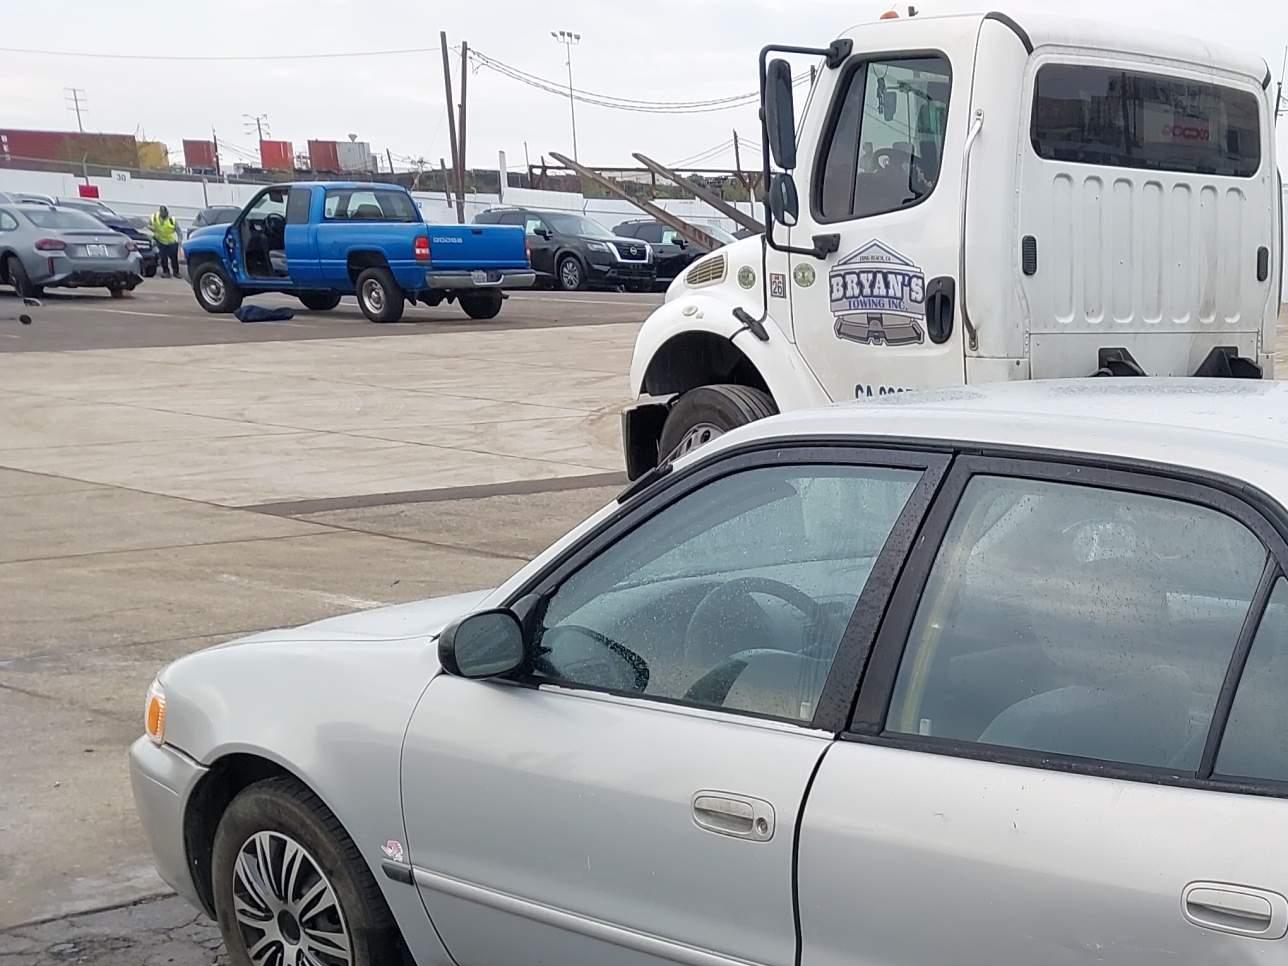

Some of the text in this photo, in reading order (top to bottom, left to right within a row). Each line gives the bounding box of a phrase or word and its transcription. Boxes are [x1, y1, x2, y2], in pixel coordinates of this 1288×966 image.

[772, 280, 783, 295] 26
[830, 270, 925, 303] BRYAN'S
[848, 298, 885, 311] TOWING
